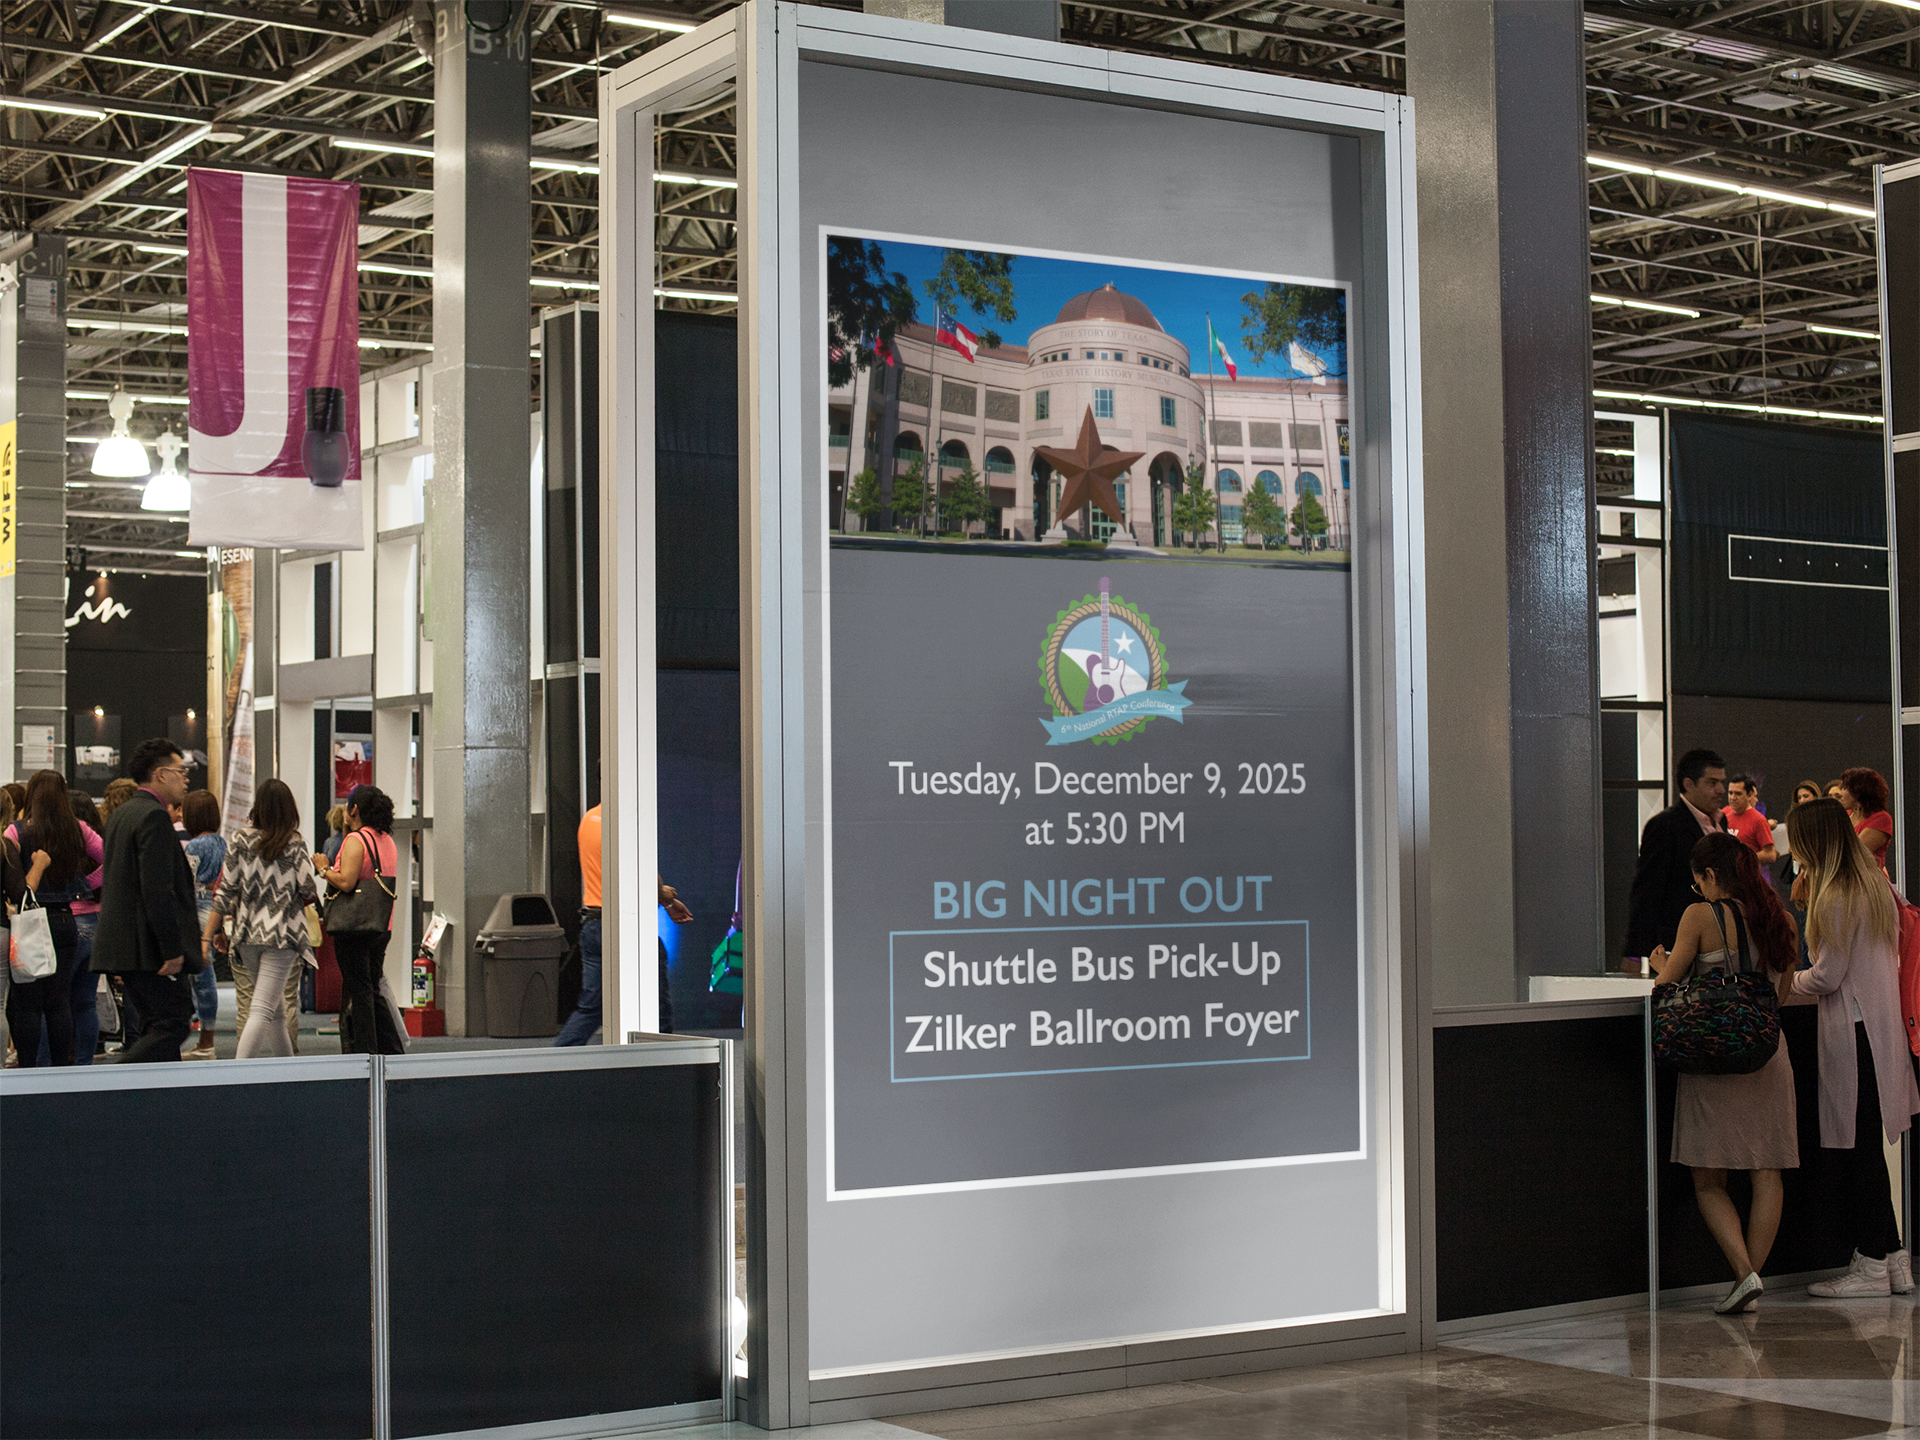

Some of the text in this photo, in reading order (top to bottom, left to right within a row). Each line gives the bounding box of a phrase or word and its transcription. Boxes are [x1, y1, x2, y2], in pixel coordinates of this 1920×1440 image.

[1060, 328, 1149, 342] THE STORY OF TEXAS
[1041, 369, 1064, 379] TEXAS
[1065, 368, 1092, 377] STATE
[1094, 368, 1133, 380] HISTORY
[1073, 714, 1107, 733] National
[1107, 704, 1129, 720] RTAP
[1130, 698, 1176, 713] Conference
[888, 760, 1307, 805] Tuesday, December 9, 2025
[1025, 811, 1185, 846] at 5:30 PM
[933, 875, 1273, 920] BIG NIGHT OUT
[923, 941, 1281, 989] Shuttle Bus Pick-Up
[904, 1002, 1300, 1054] Zilker Ballroom Foyer
